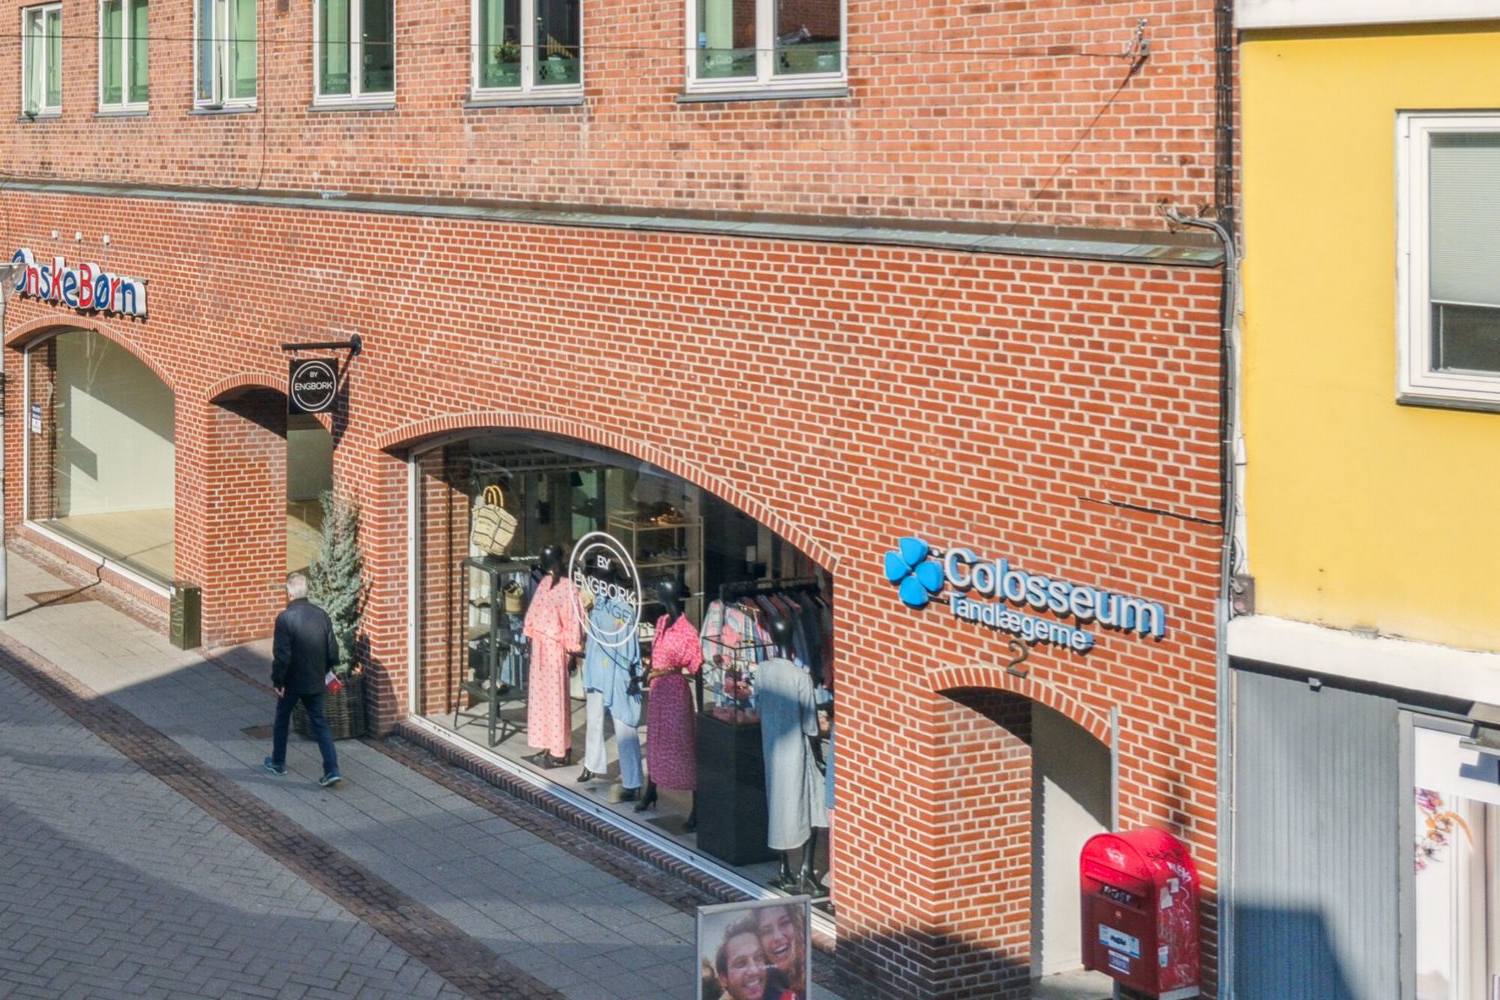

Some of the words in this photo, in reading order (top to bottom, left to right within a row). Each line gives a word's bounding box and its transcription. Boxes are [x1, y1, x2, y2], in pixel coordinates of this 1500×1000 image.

[294, 381, 333, 391] ENGBORK
[596, 554, 611, 570] BY
[573, 571, 636, 605] ENGBORK
[944, 548, 1162, 637] Colosseum
[949, 592, 1090, 652] Tandlægerne
[1006, 639, 1030, 679] 2
